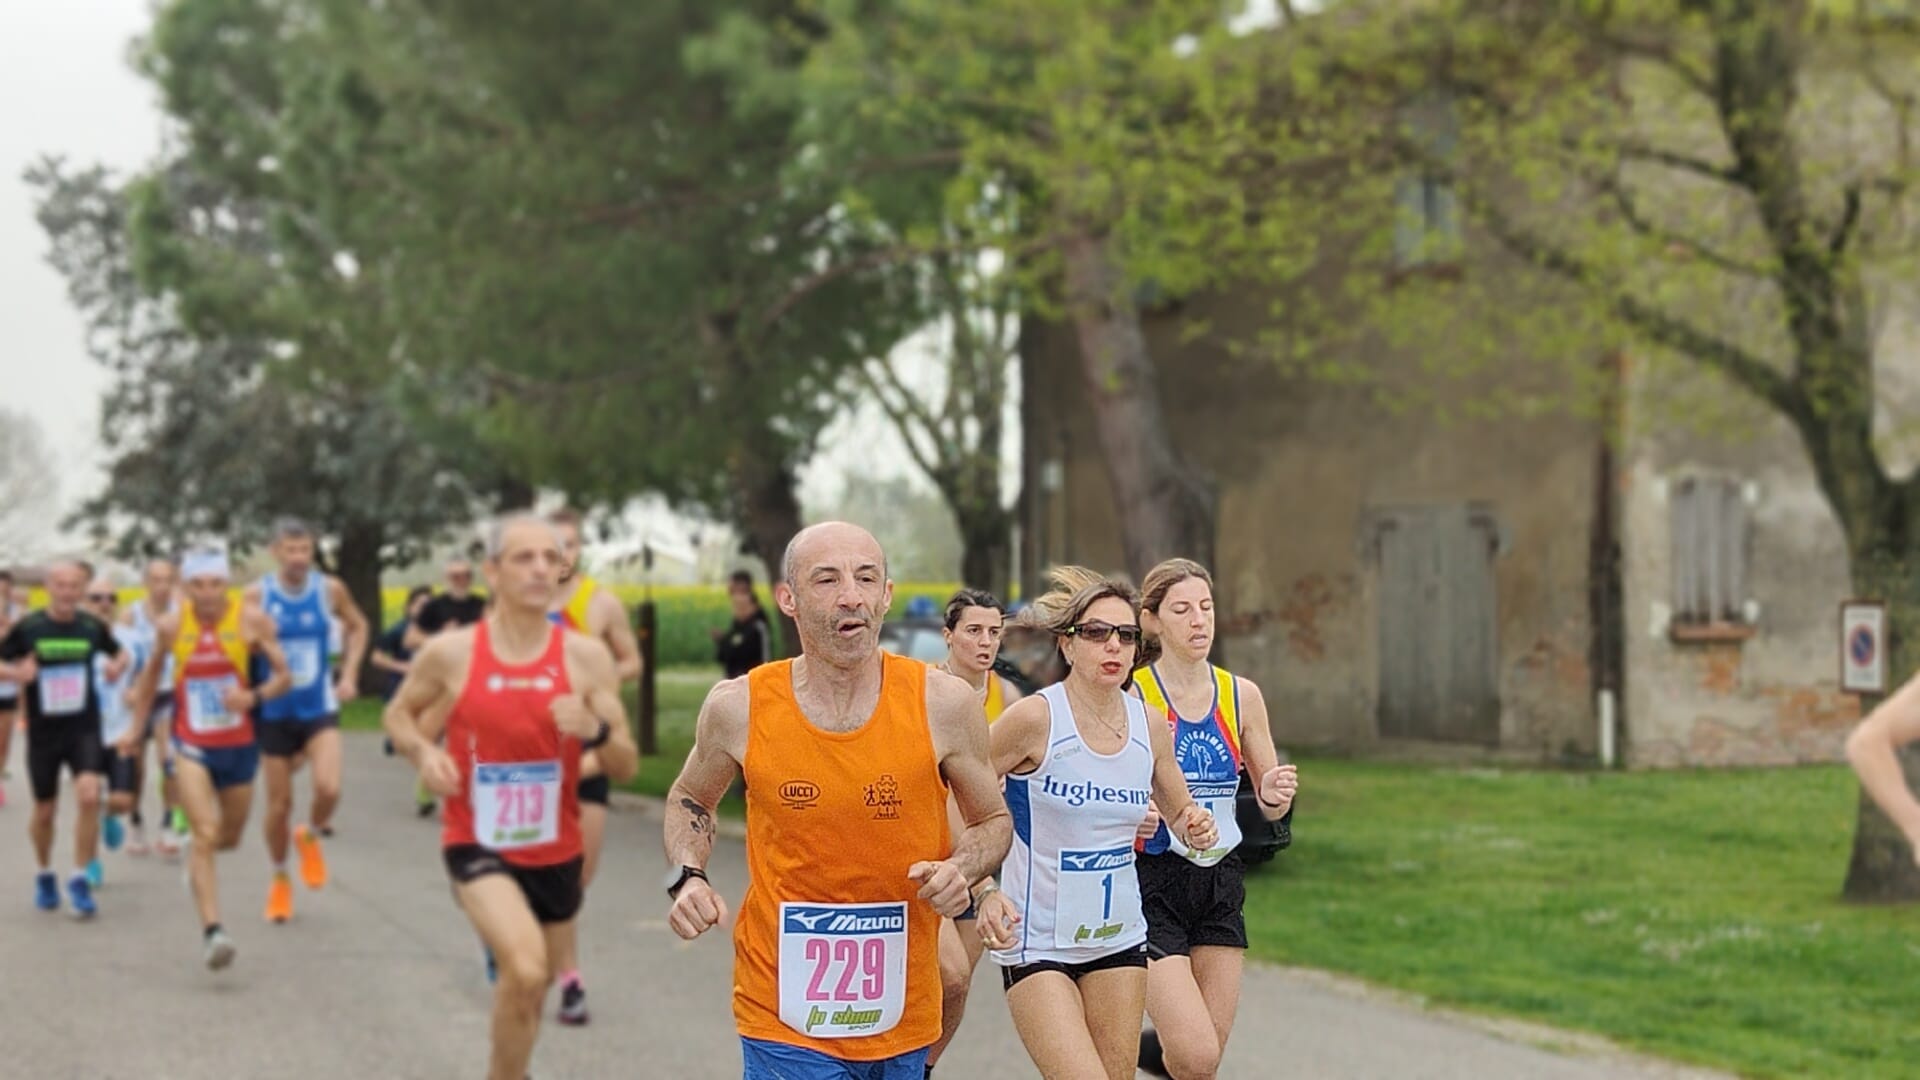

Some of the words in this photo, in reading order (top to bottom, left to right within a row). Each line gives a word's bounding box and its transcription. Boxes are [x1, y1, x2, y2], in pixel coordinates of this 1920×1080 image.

[495, 782, 545, 827] 213
[783, 785, 814, 798] LUCCI
[1101, 872, 1113, 921] 1
[805, 937, 885, 1001] 229
